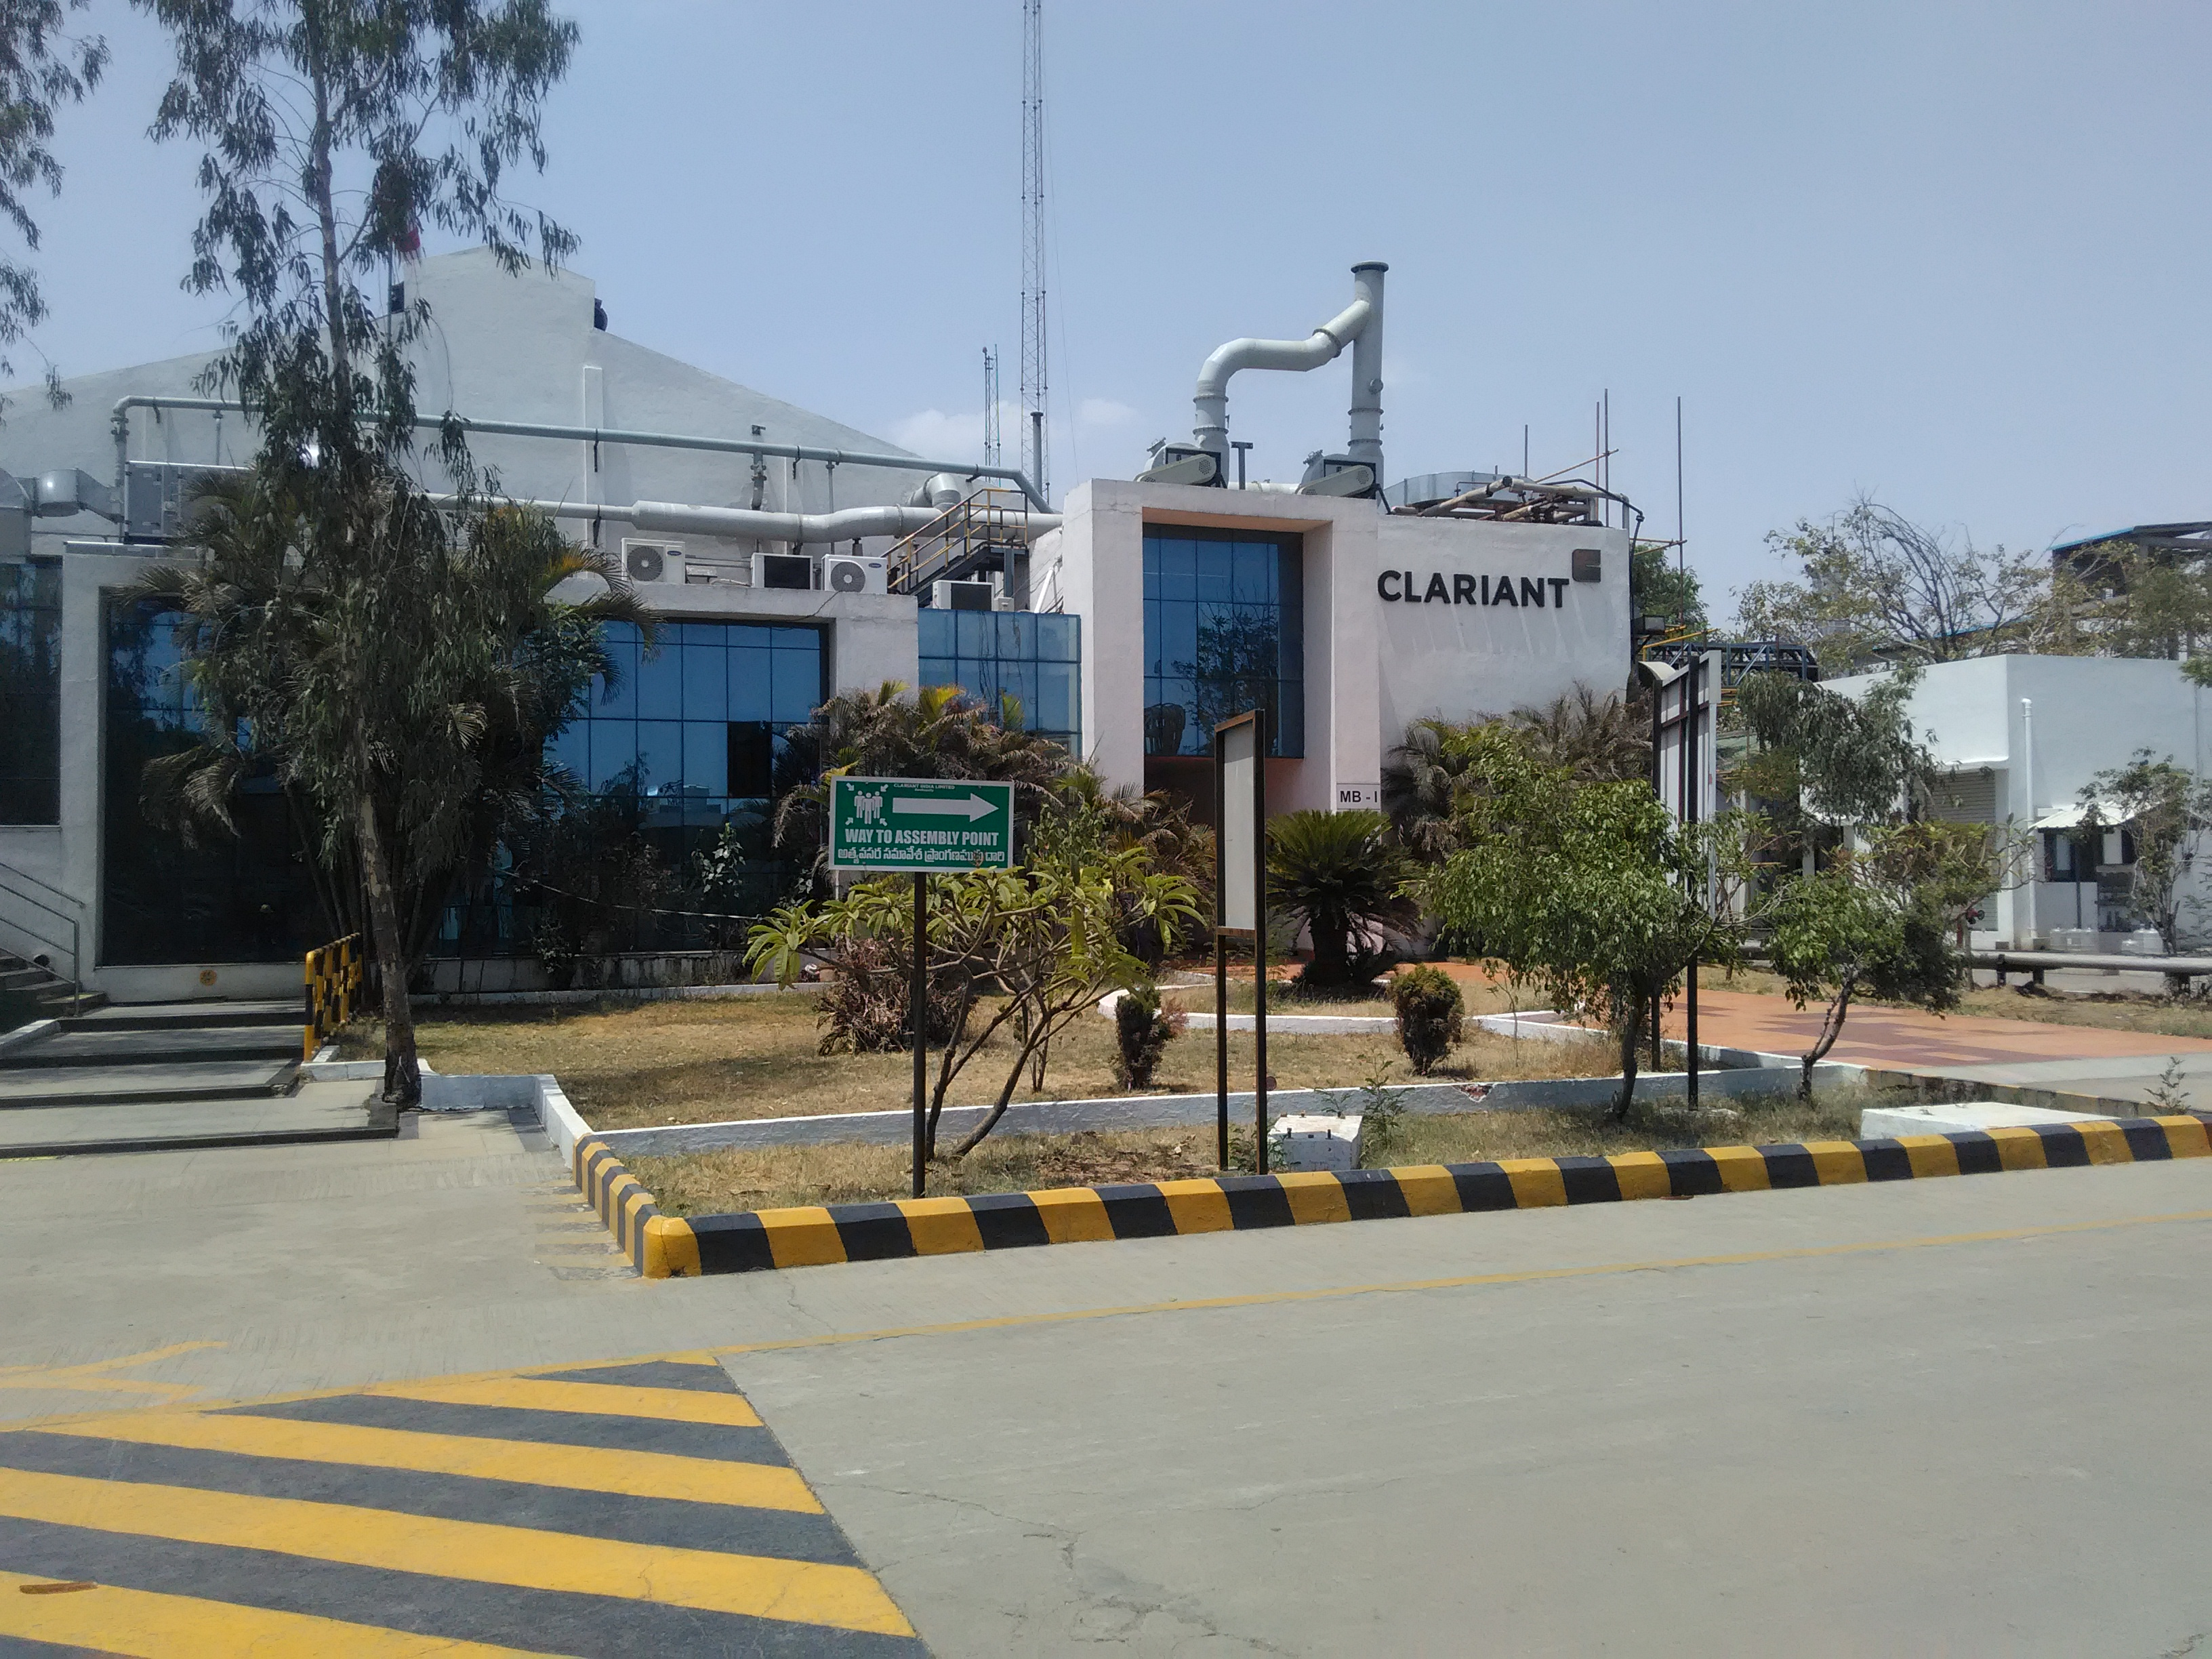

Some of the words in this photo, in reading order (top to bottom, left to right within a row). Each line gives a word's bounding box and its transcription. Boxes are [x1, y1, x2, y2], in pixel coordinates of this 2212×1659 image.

[1377, 570, 1570, 608] CLARIANT
[1340, 790, 1361, 802] MB
[845, 829, 874, 843] WAY
[876, 830, 893, 844] TO
[895, 830, 960, 846] ASSEMBLY
[962, 832, 999, 846] POINT
[838, 846, 882, 864] అత్యవసర
